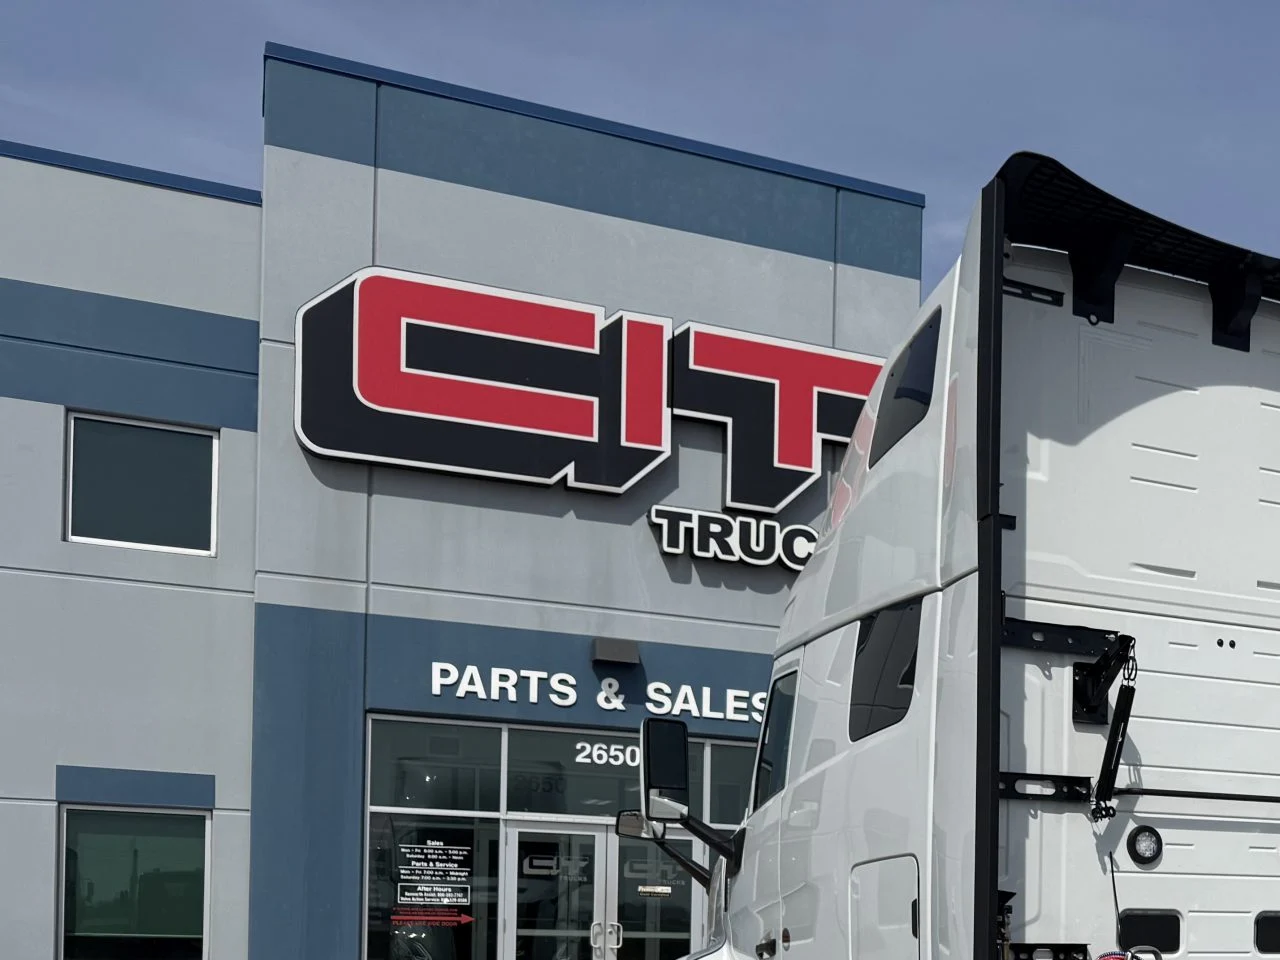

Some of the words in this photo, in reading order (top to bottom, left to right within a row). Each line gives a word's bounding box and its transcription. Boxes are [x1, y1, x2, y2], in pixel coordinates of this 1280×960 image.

[294, 266, 888, 513] CIT
[431, 661, 577, 707] PARTS
[596, 677, 626, 710] &
[575, 741, 640, 767] 2650
